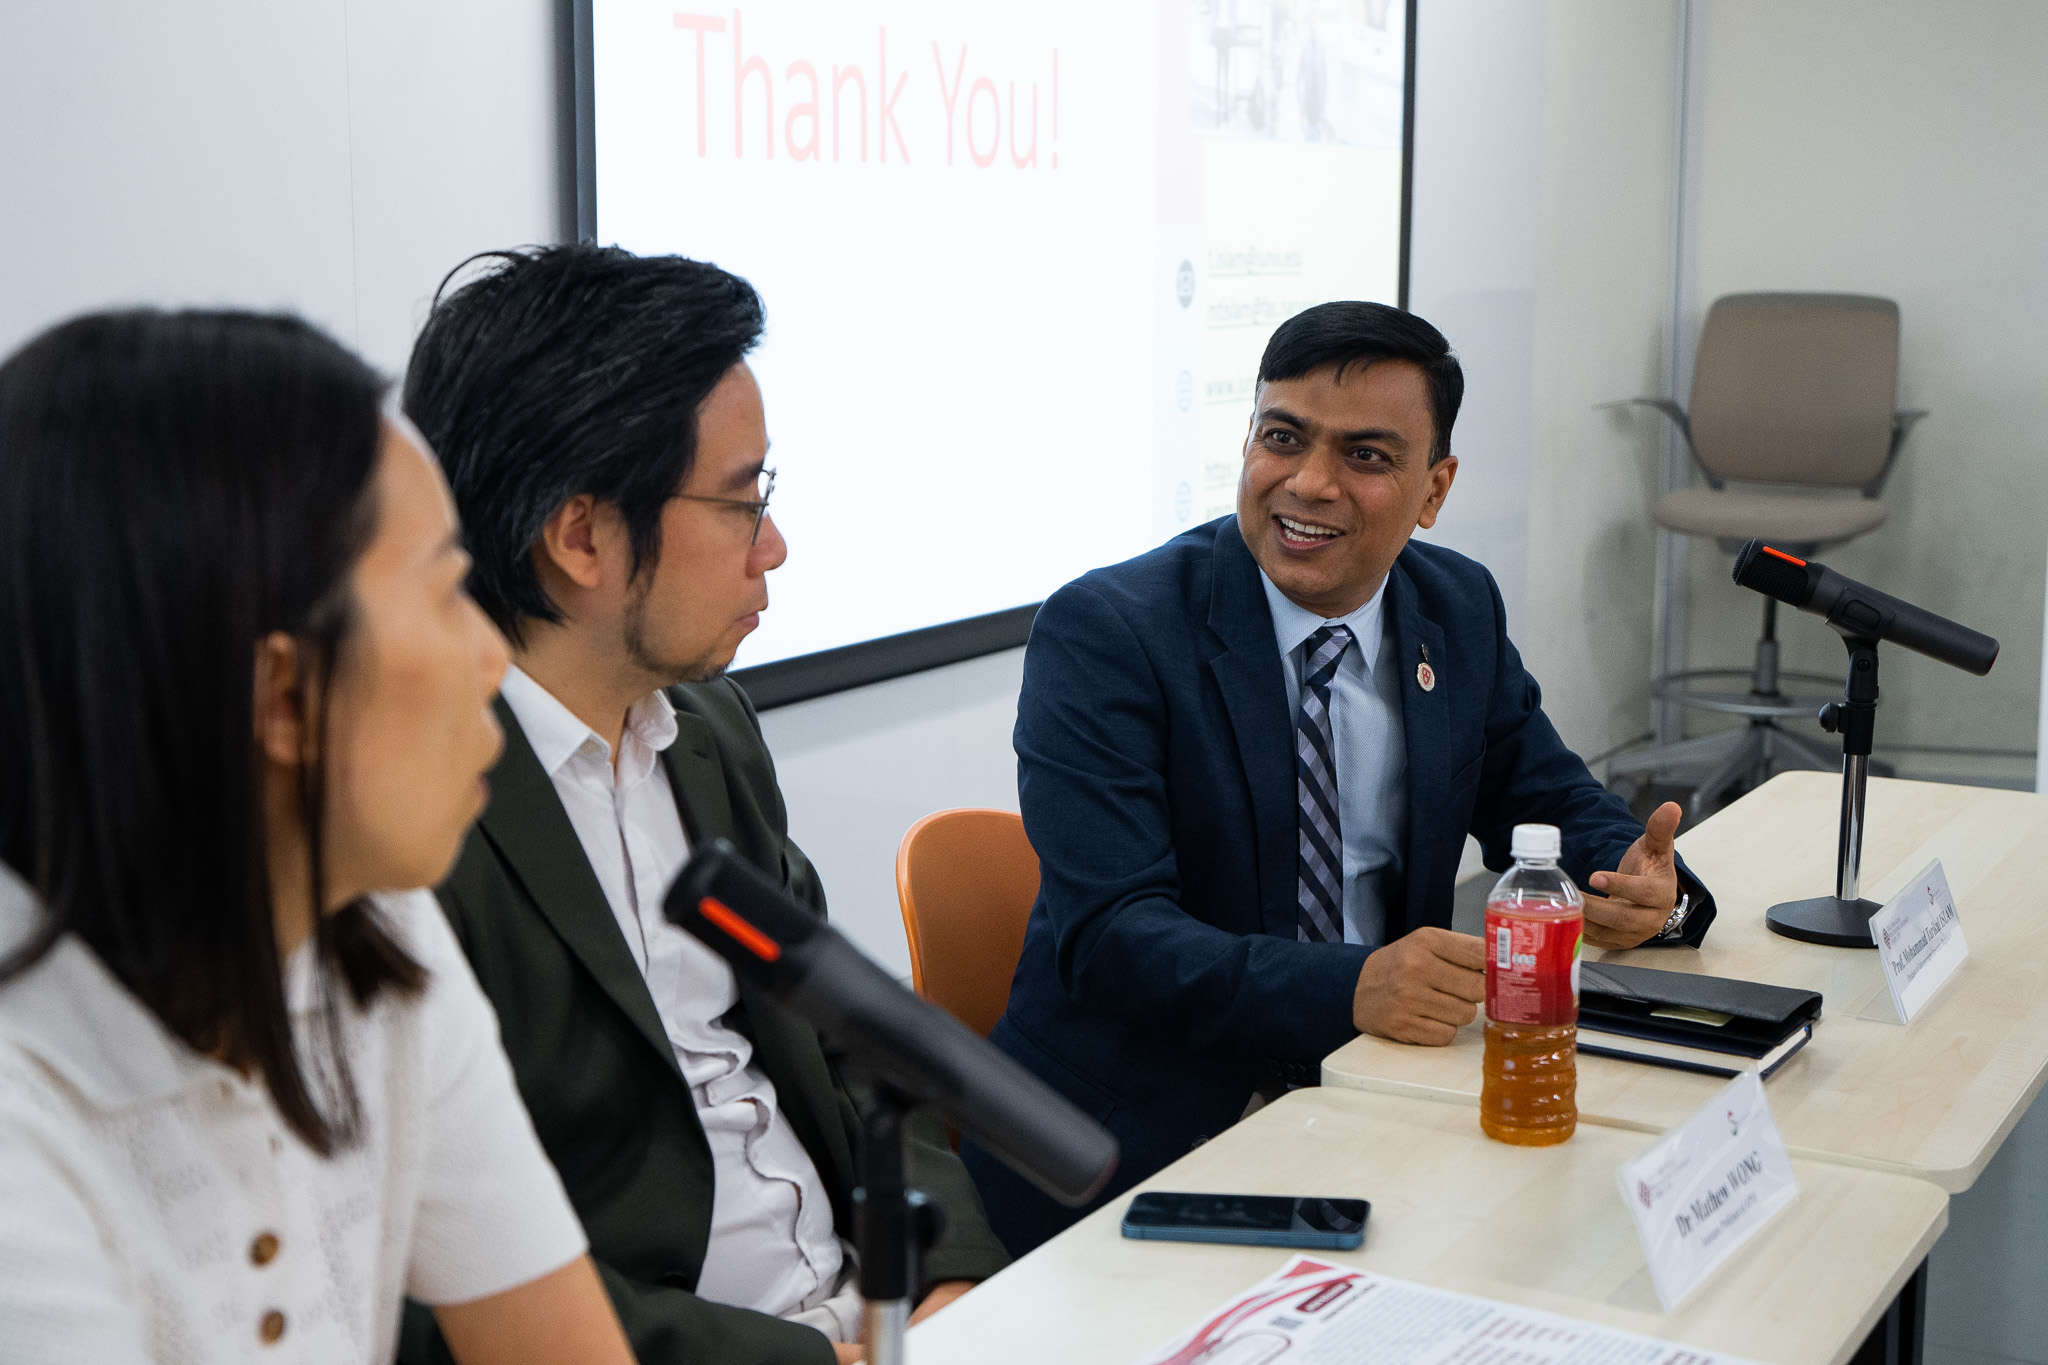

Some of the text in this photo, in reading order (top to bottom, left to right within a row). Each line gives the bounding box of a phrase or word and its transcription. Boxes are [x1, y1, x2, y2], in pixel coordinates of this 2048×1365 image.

[672, 9, 1059, 171] Thank You!
[1939, 903, 1954, 927] ISLAM
[1727, 1150, 1762, 1194] WONG
